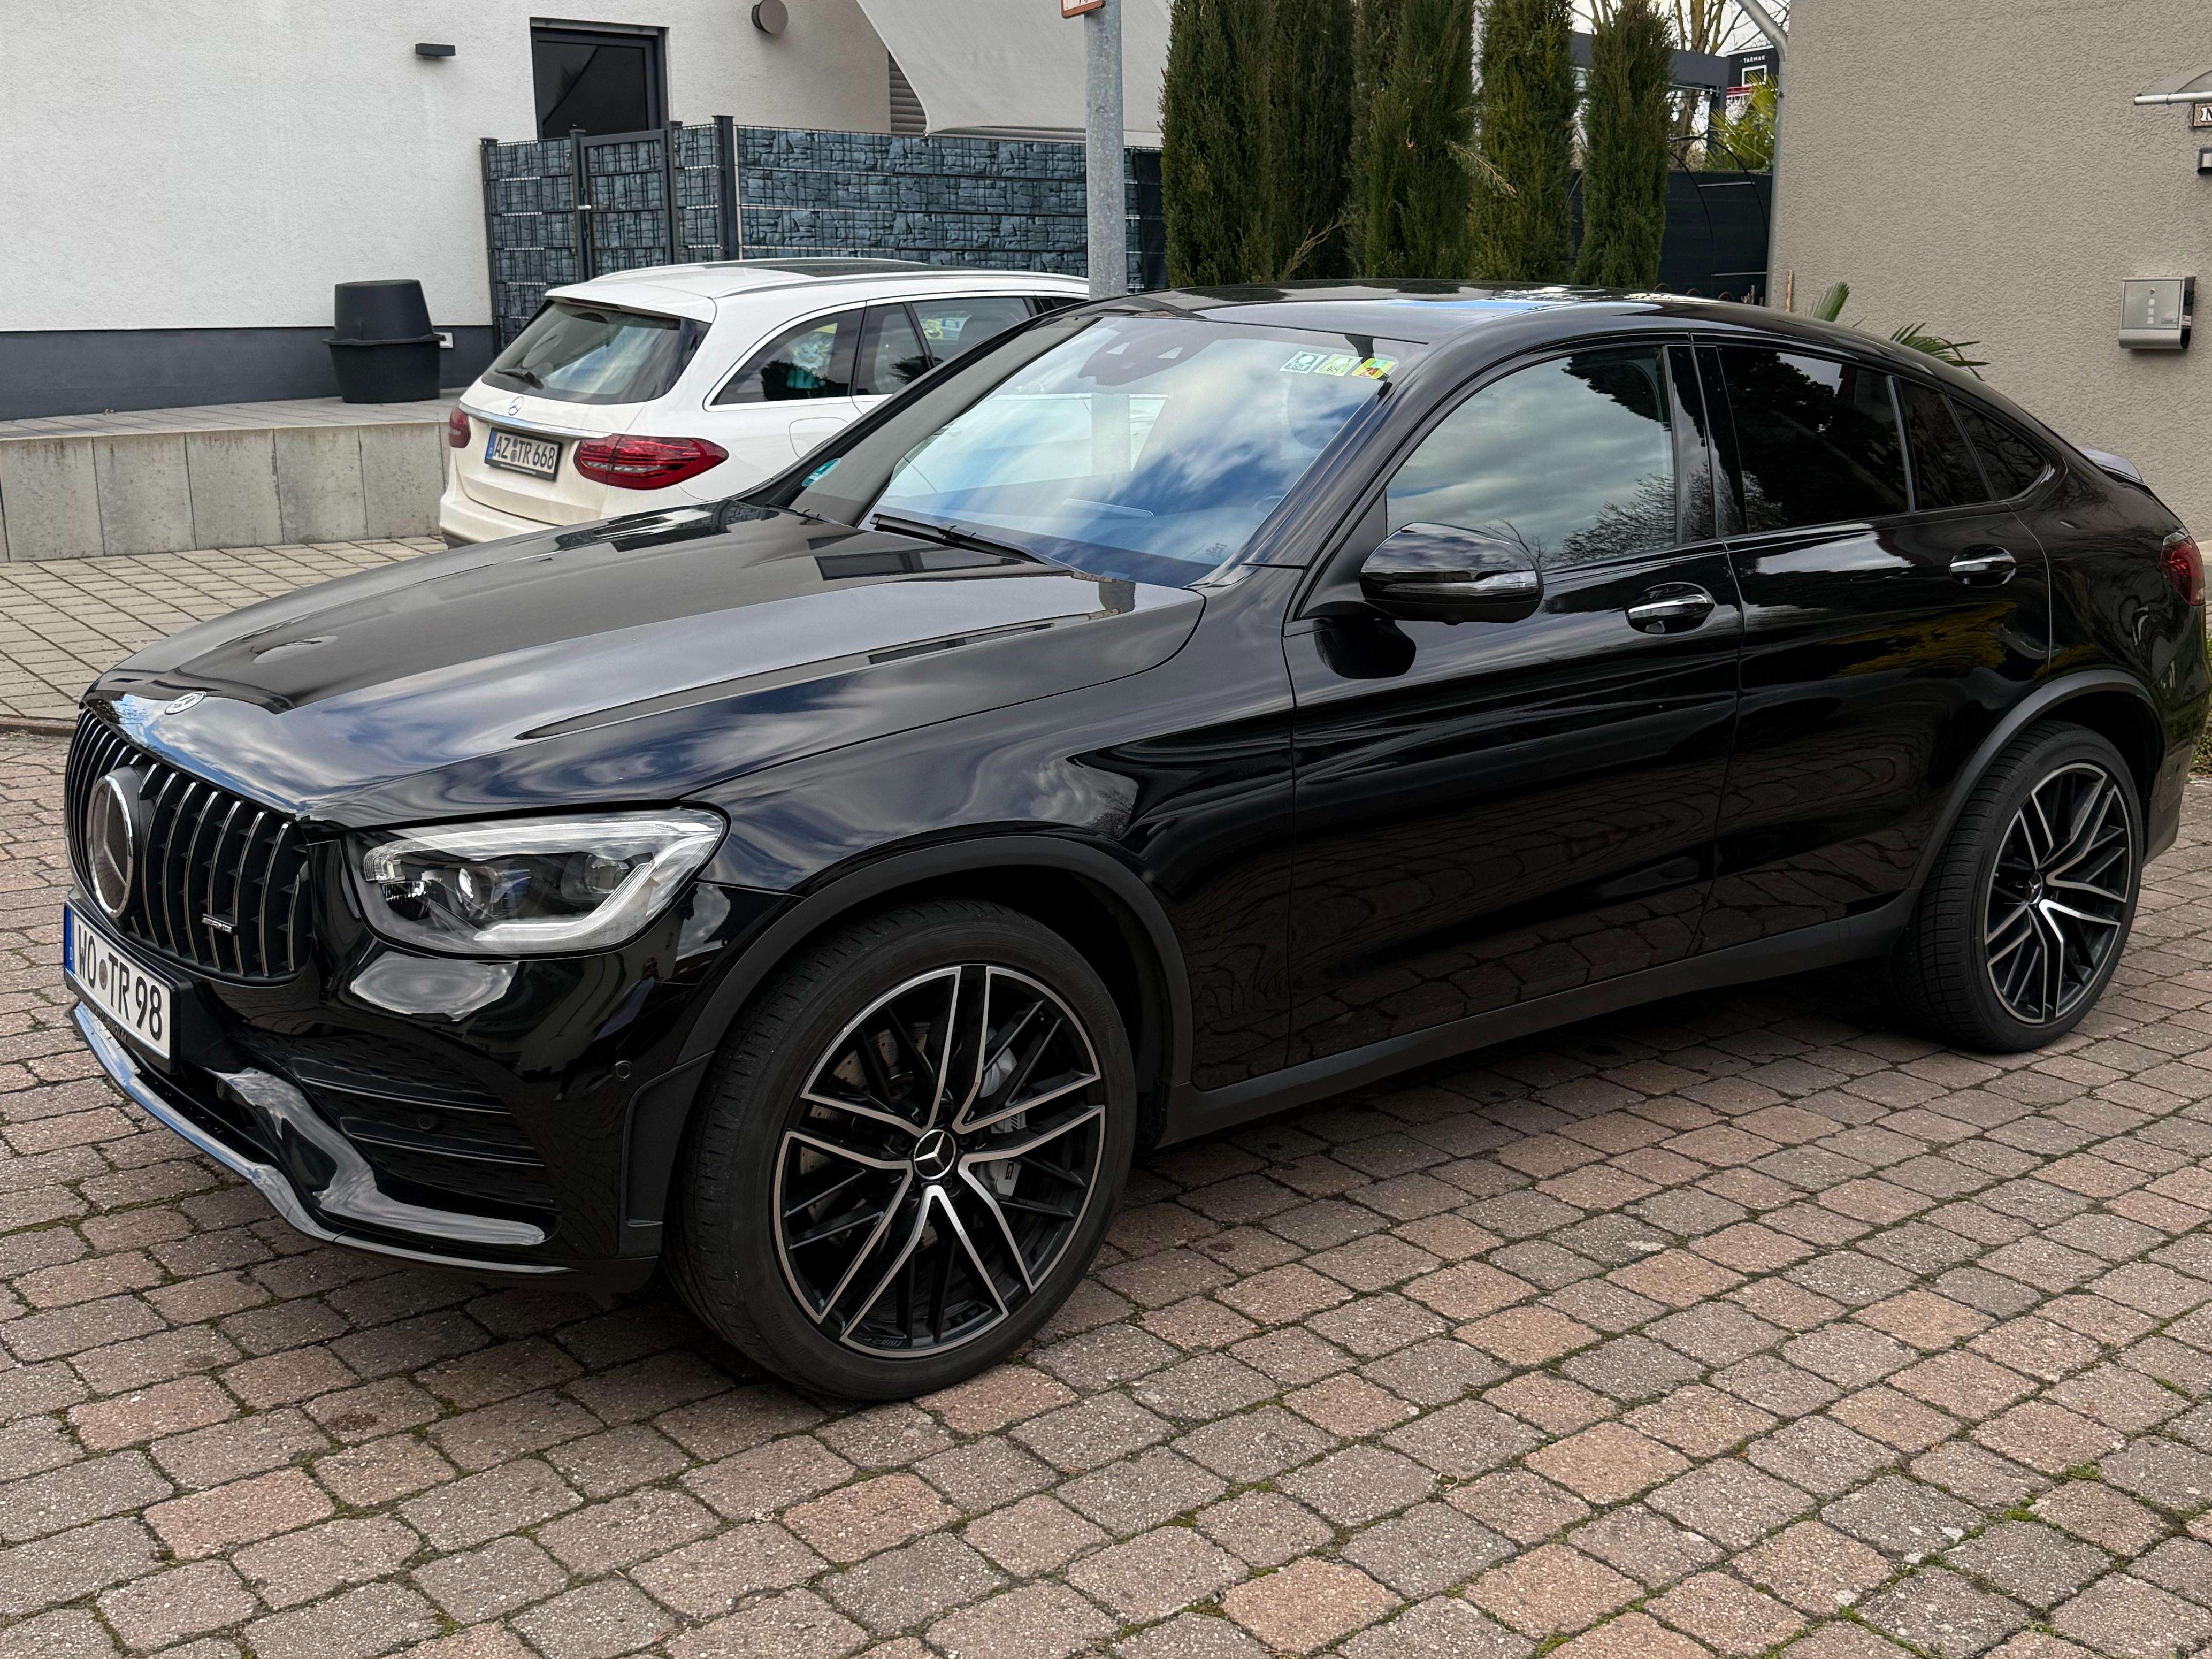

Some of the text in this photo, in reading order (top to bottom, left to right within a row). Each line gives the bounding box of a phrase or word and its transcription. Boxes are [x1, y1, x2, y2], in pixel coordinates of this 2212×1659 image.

[1743, 55, 1766, 64] TARMAK
[494, 436, 511, 459] AZ
[518, 440, 532, 464] TR
[532, 445, 555, 470] 668
[79, 924, 96, 989] WO
[108, 952, 130, 1021] TR
[135, 976, 163, 1041] 98
